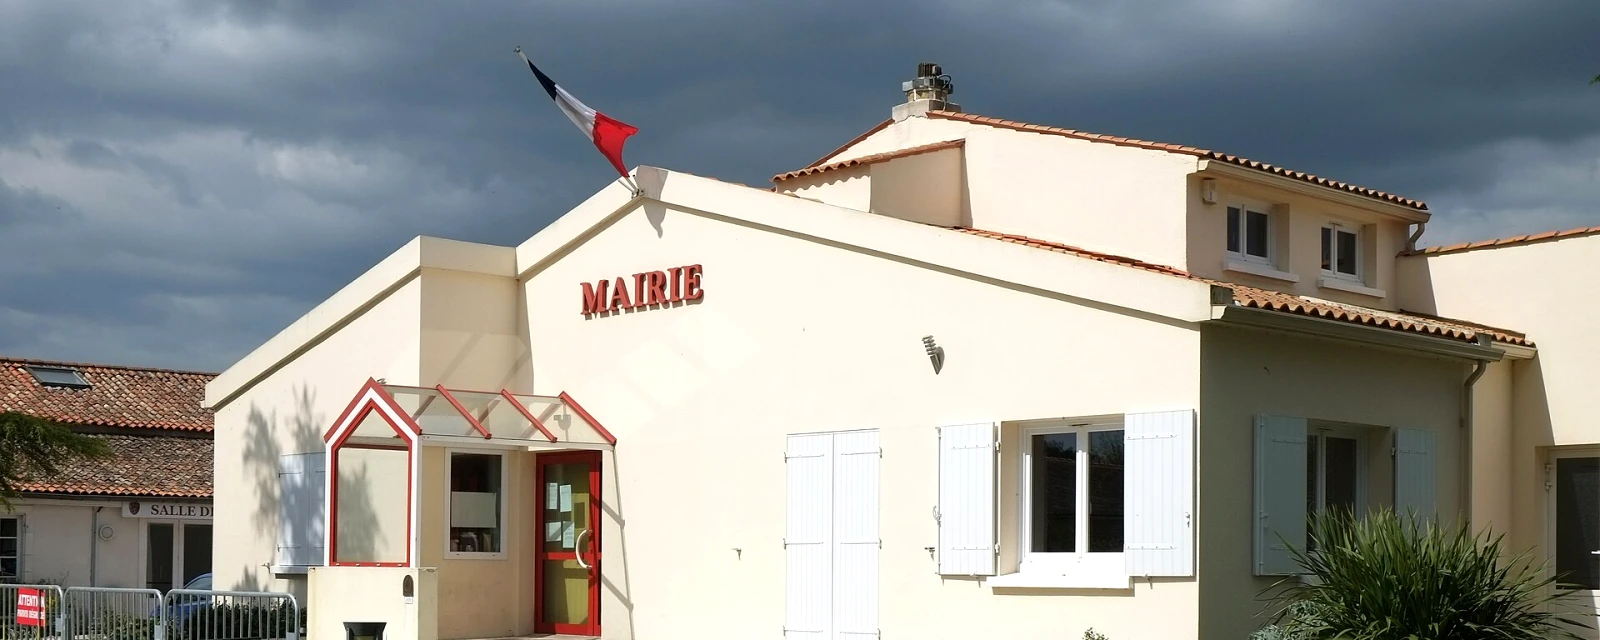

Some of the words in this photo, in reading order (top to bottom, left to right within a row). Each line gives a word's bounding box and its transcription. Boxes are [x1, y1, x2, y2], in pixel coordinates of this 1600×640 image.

[580, 264, 704, 315] MAIRIE
[151, 504, 196, 516] SALLE
[18, 594, 45, 607] ATTENTIN
